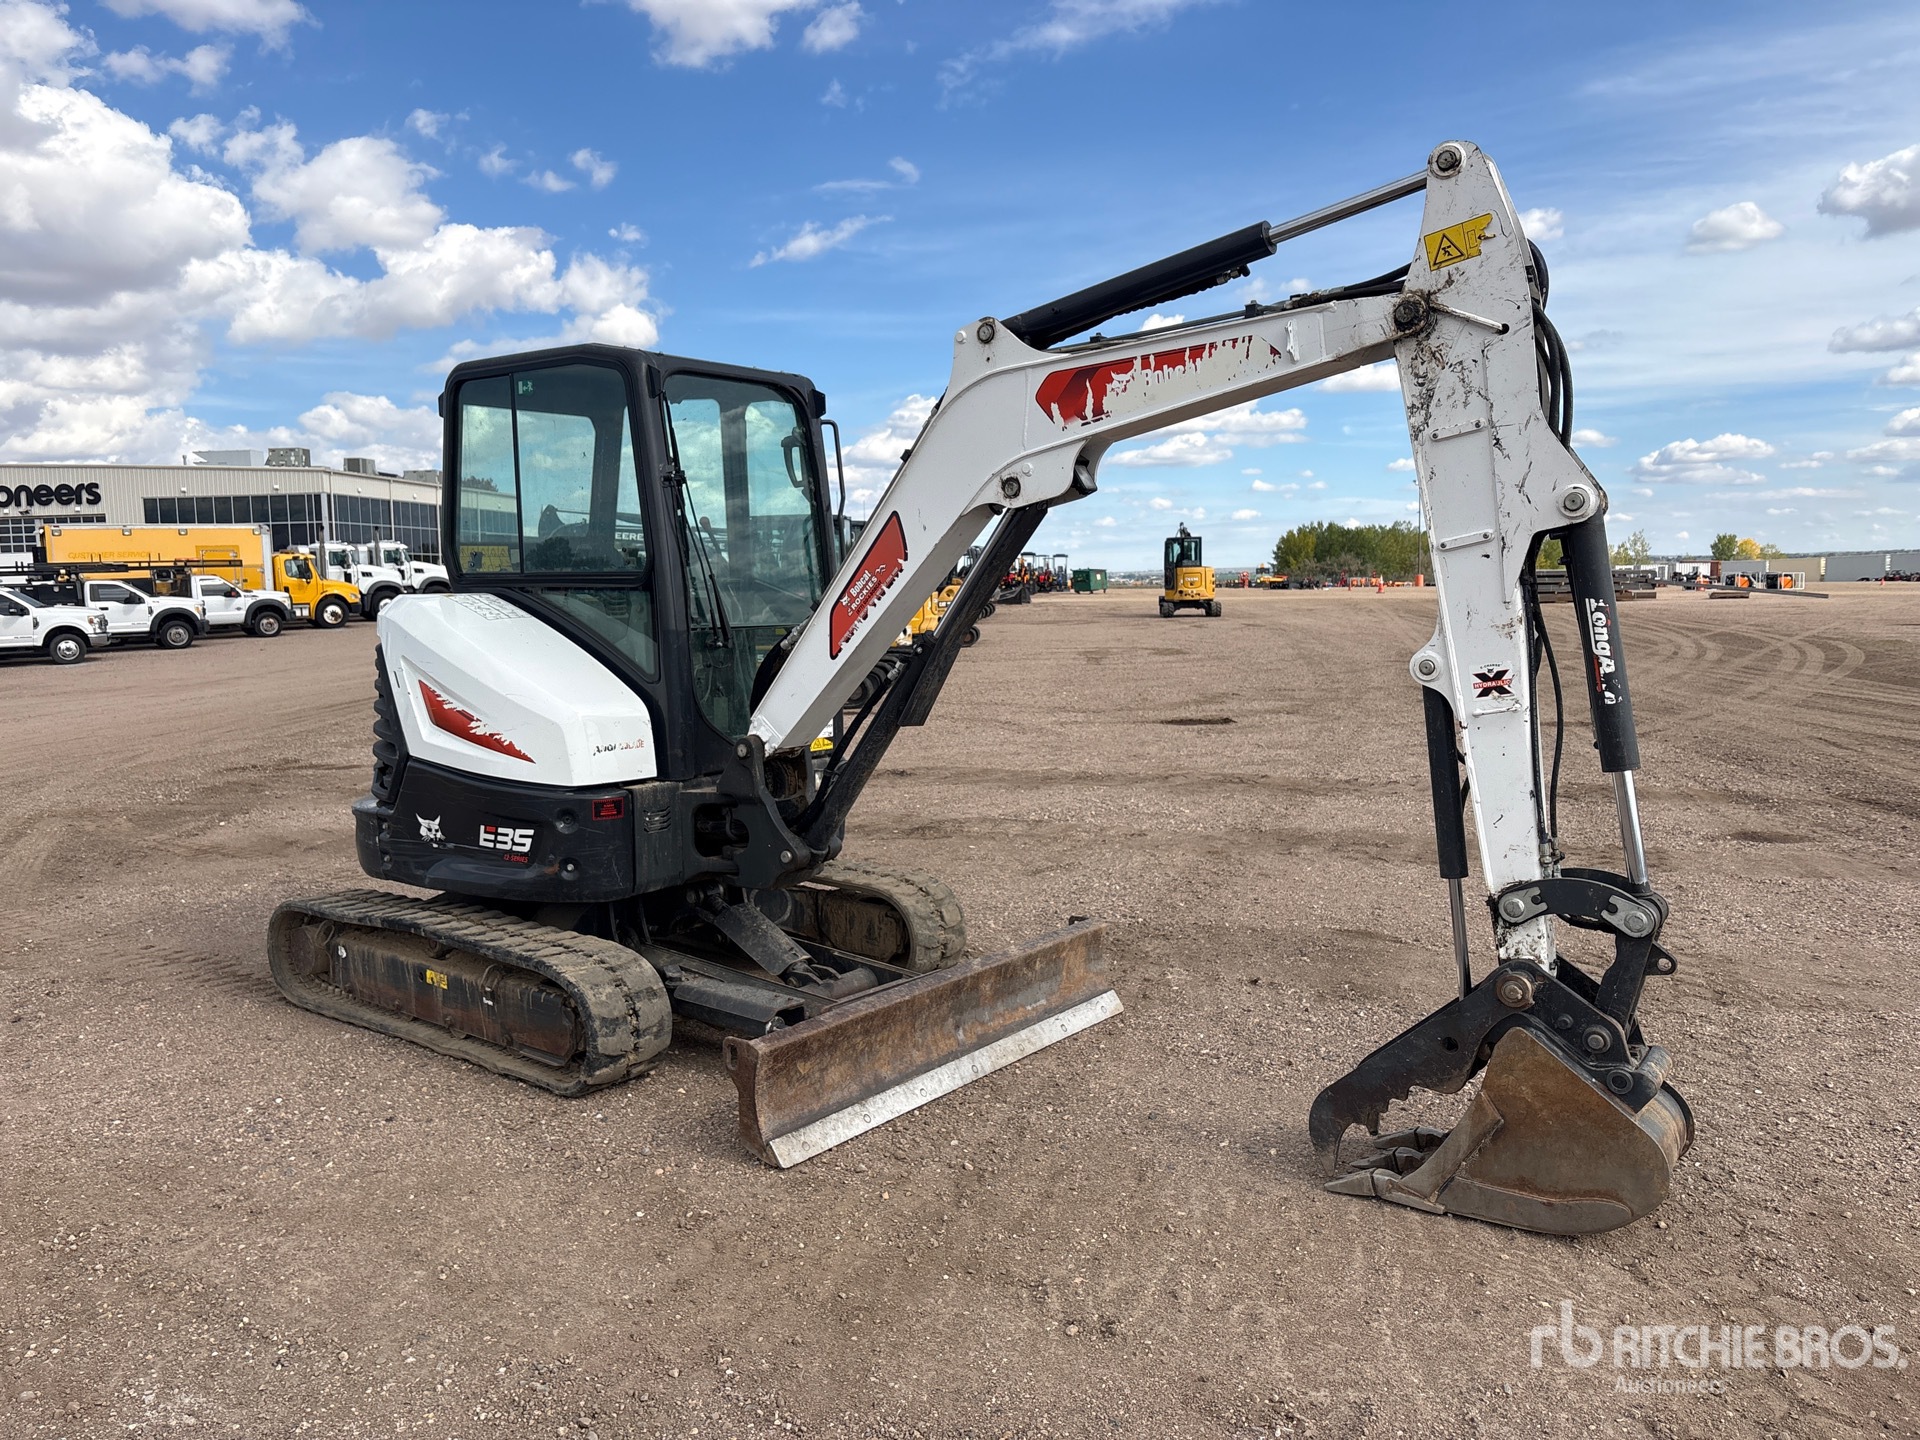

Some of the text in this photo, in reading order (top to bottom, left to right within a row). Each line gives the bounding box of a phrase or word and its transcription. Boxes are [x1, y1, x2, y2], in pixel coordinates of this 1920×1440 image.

[849, 569, 872, 597] Bobcat
[850, 575, 878, 611] ROCKIES
[1474, 680, 1512, 689] HYDRAULIC
[479, 825, 535, 853] E35
